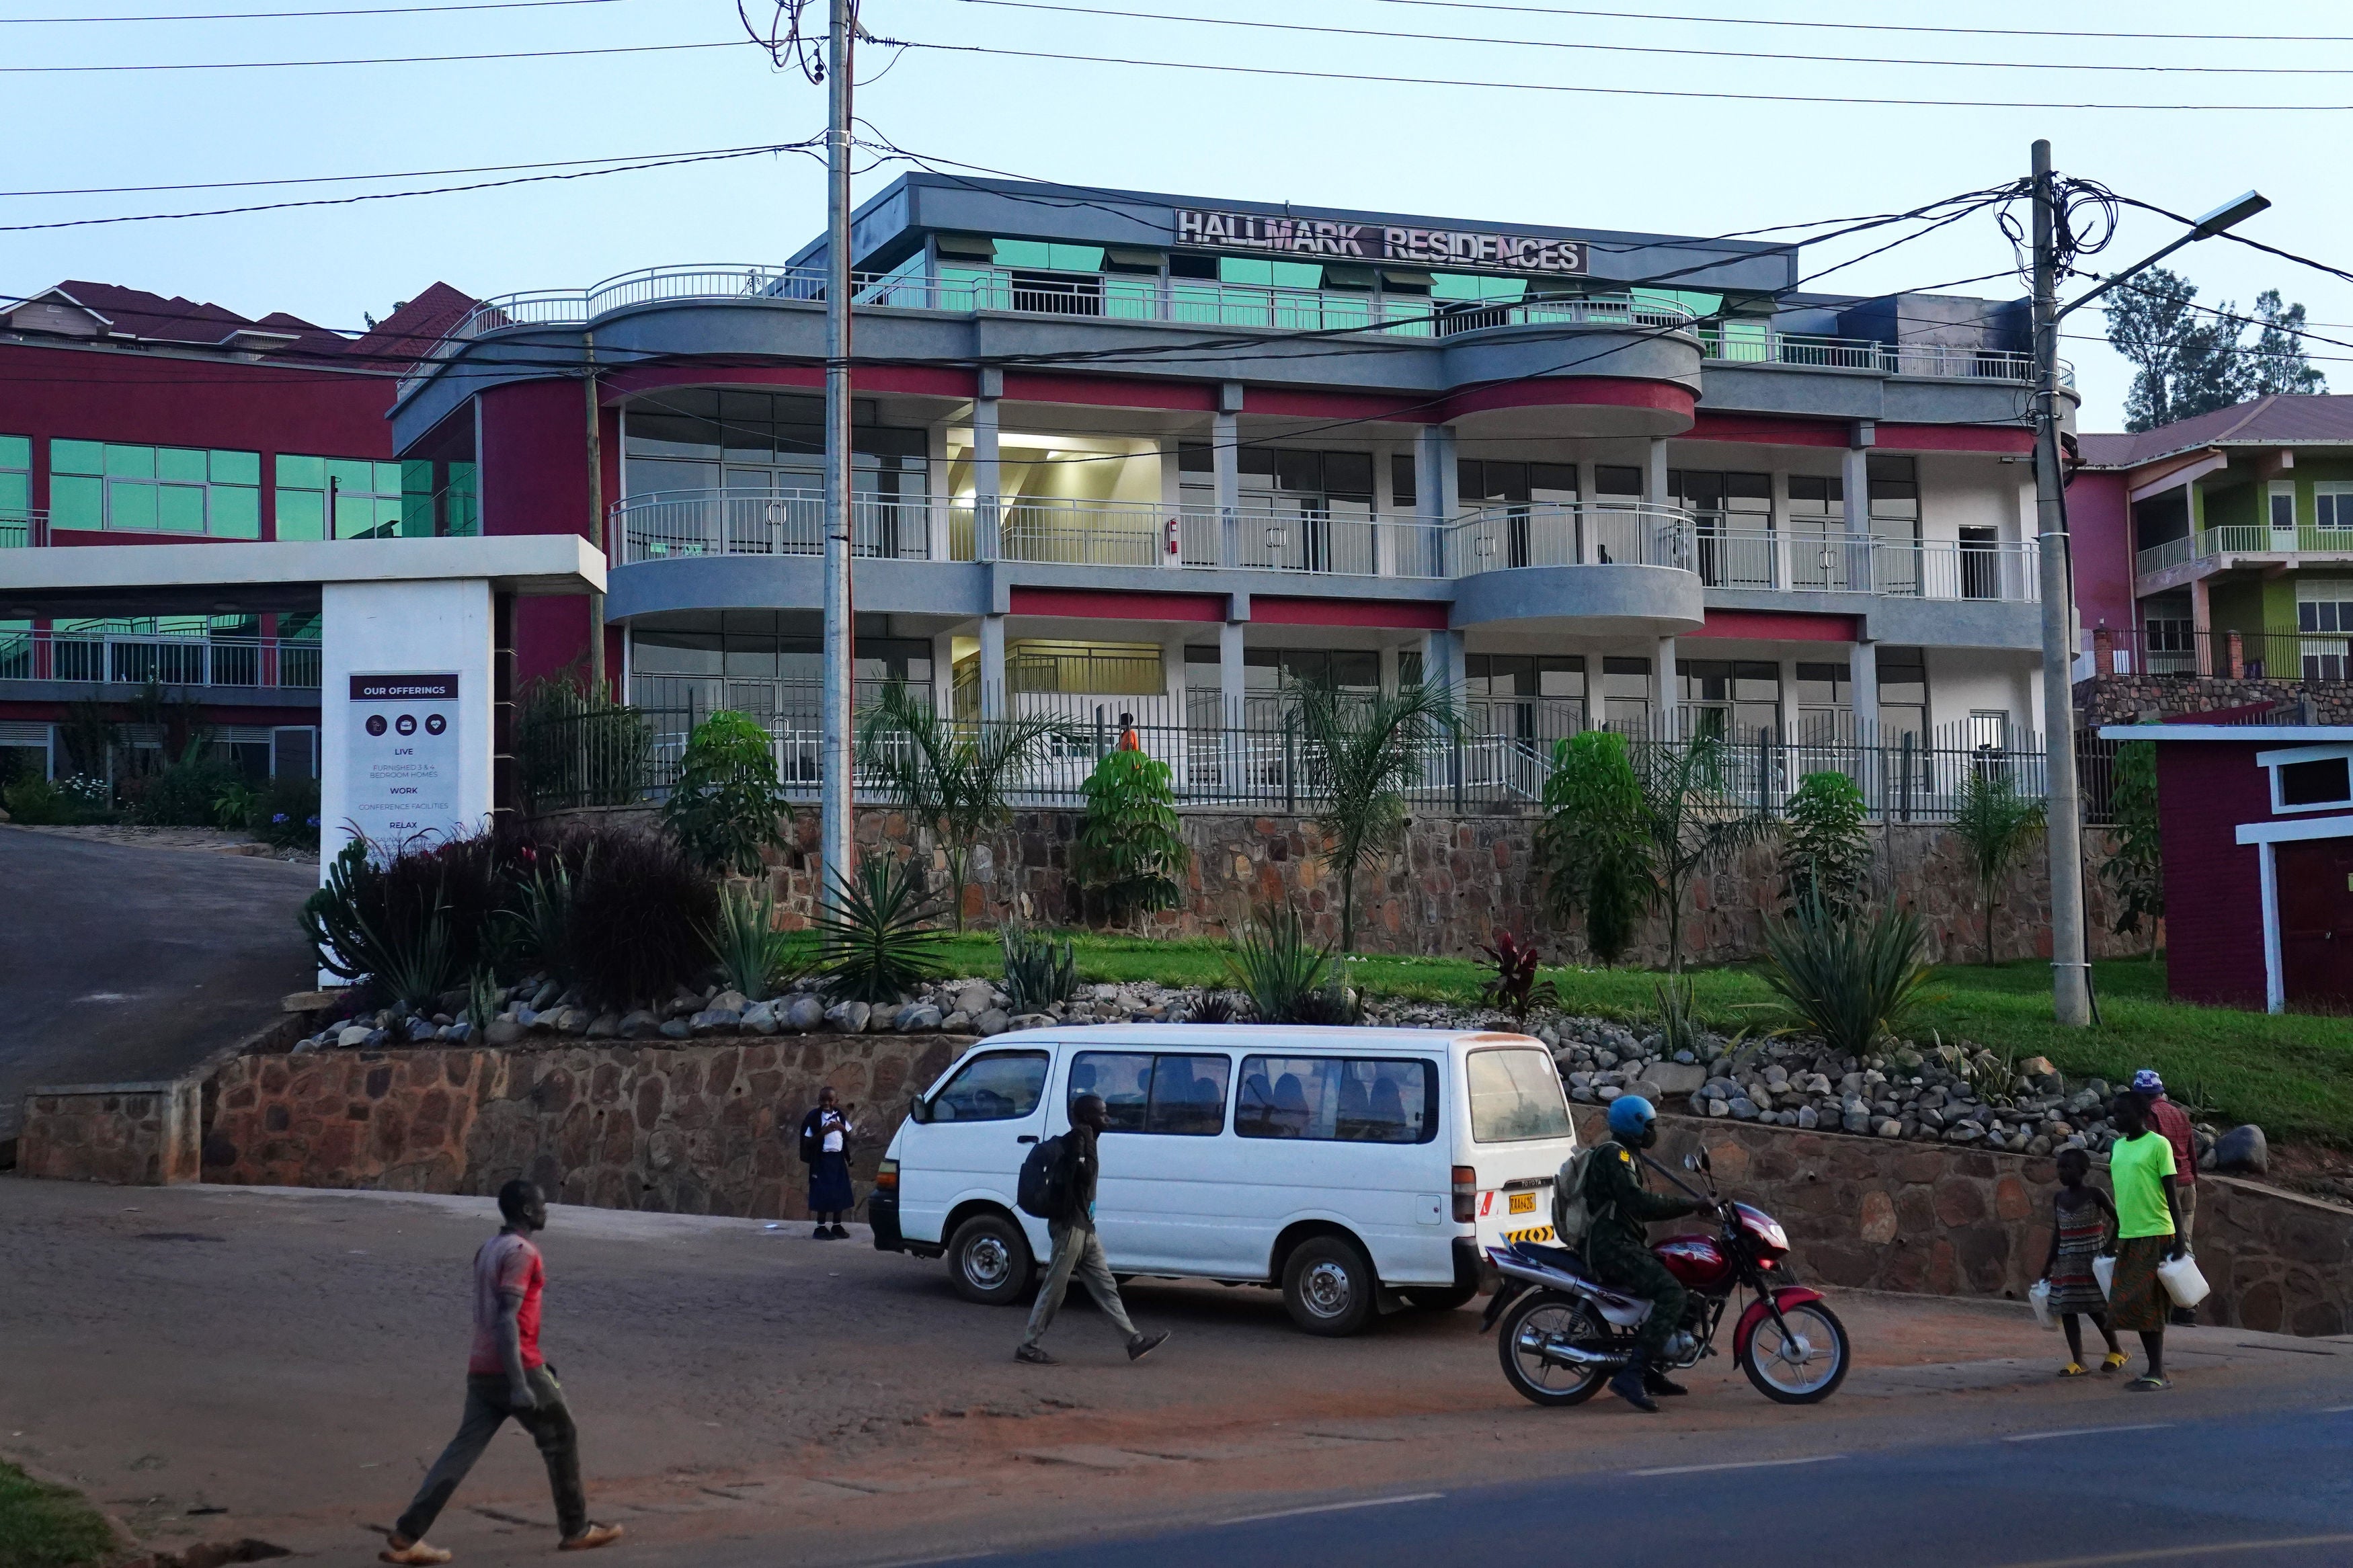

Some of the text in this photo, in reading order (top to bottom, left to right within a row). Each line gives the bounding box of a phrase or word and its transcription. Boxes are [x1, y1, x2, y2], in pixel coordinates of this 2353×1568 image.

[1179, 211, 1579, 270] HALLMARK RESIDENCES
[364, 686, 446, 695] OUR OFFERINGS
